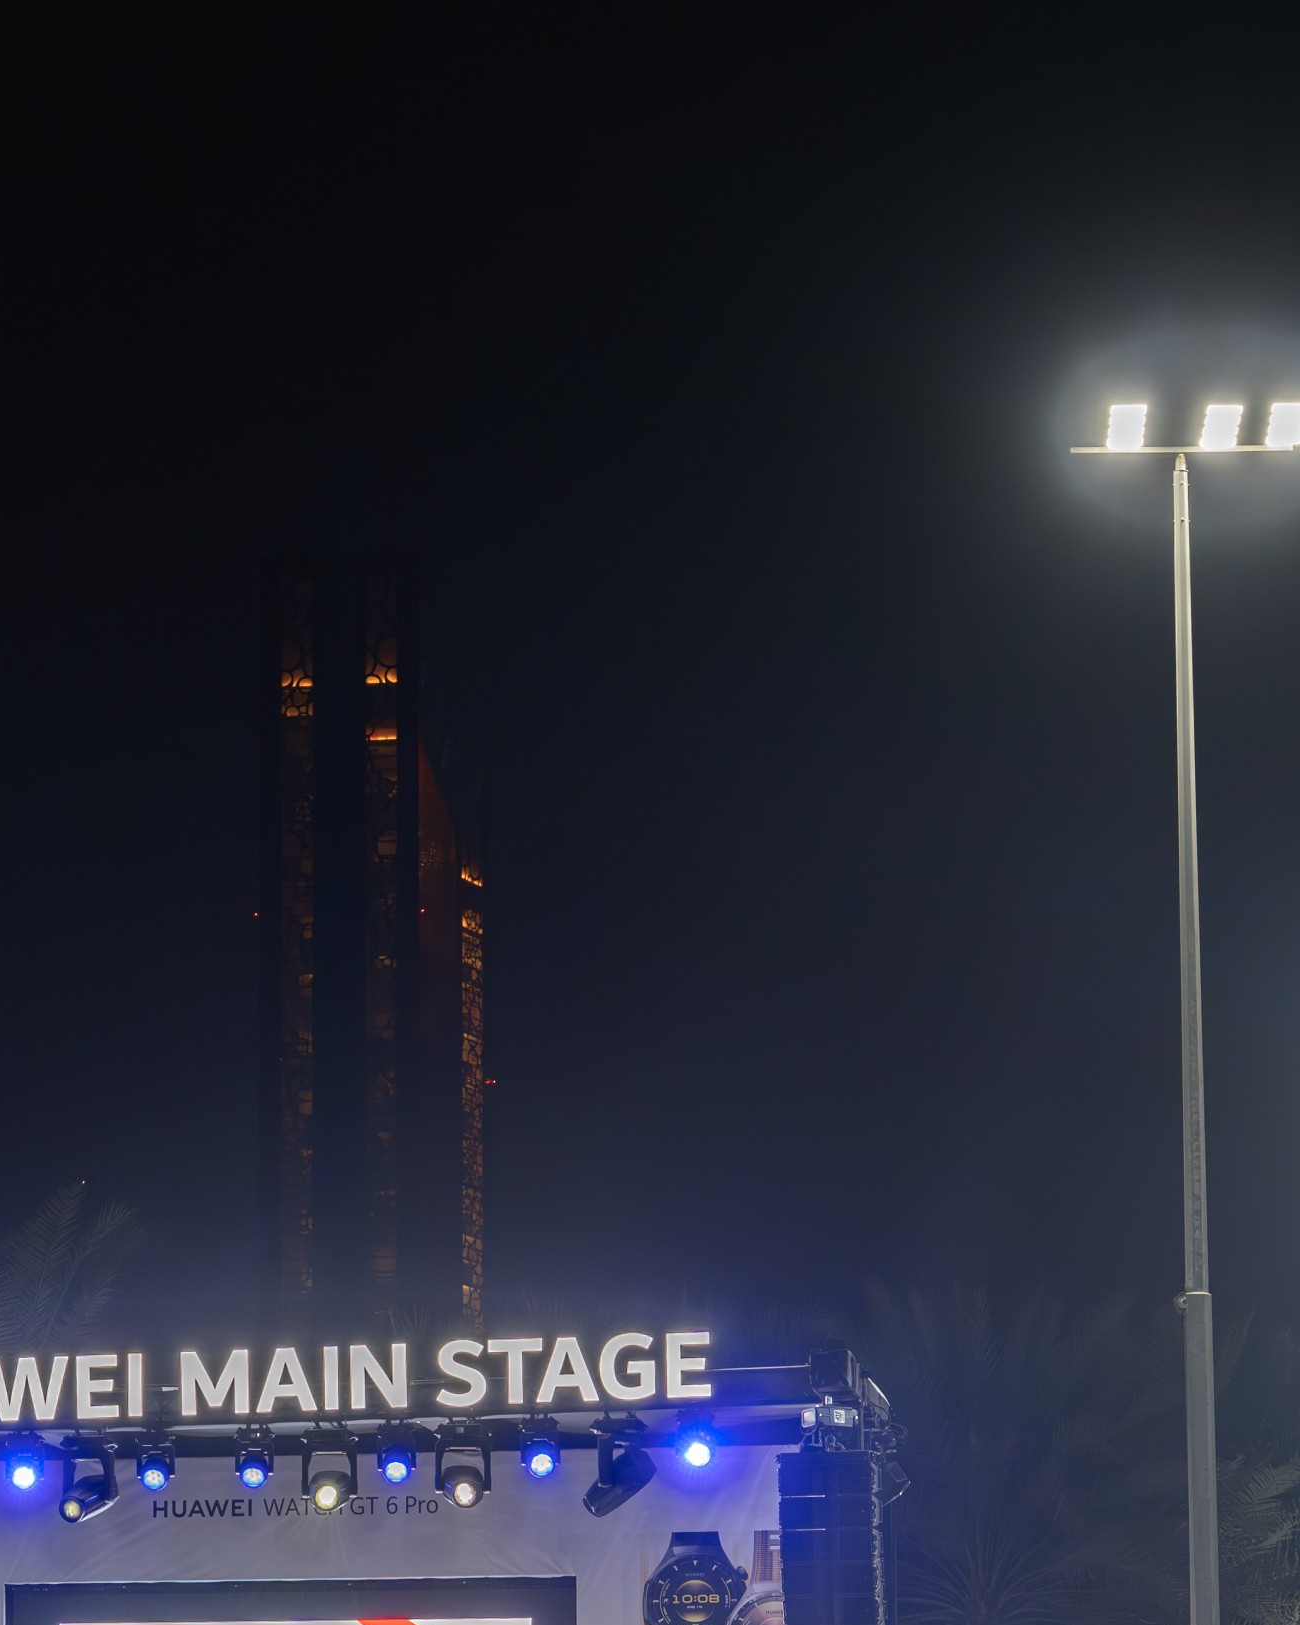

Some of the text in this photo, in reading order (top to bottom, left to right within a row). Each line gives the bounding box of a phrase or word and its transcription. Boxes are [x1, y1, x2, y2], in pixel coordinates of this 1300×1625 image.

[179, 1342, 407, 1416] MAIN
[436, 1331, 712, 1409] STAGE
[152, 1496, 439, 1518] HUAWEI WAT GT 6 Pro
[672, 1594, 720, 1604] 10:08
